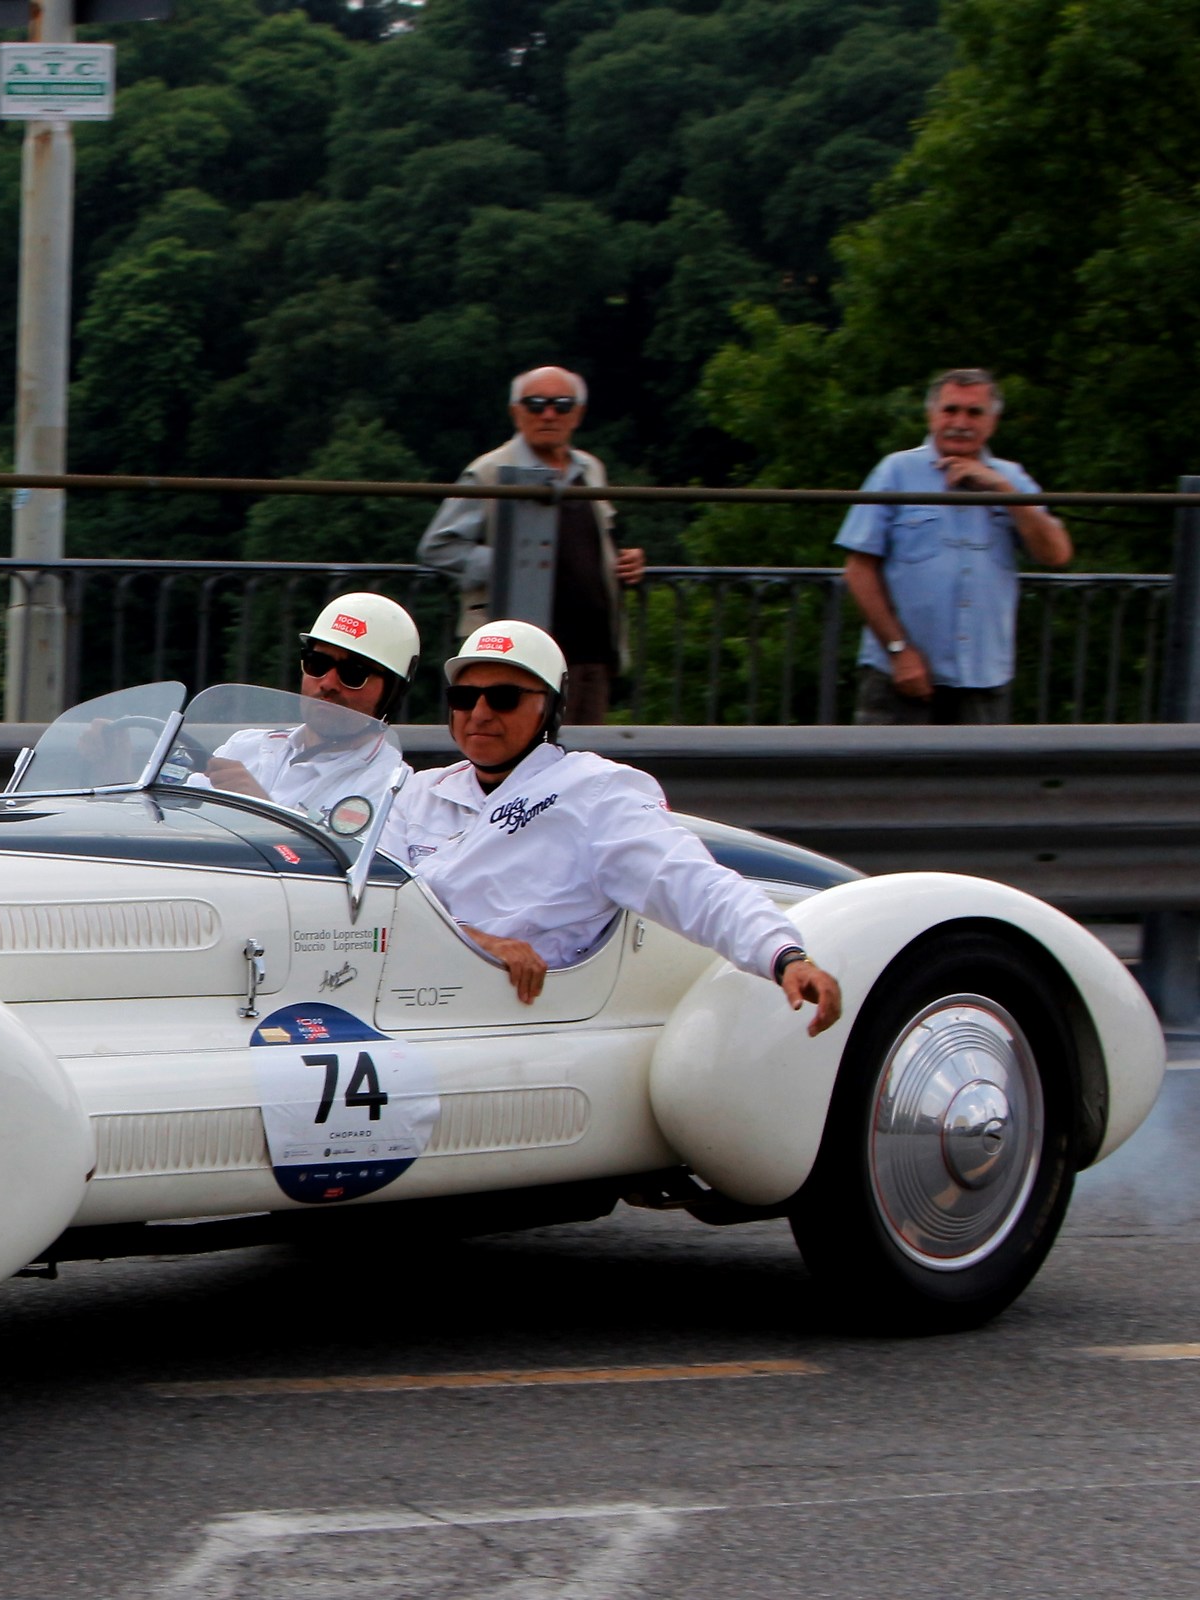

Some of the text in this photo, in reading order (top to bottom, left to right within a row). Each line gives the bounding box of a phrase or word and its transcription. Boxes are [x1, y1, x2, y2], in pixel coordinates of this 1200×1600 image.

[338, 616, 360, 627] 1000
[333, 623, 357, 635] MIGLIA
[507, 793, 558, 834] Romeo
[293, 928, 373, 942] Corrado Lopresto
[294, 940, 373, 953] Duccio Lopresto
[300, 1051, 388, 1124] 74
[329, 1129, 372, 1139] CHOPARD
